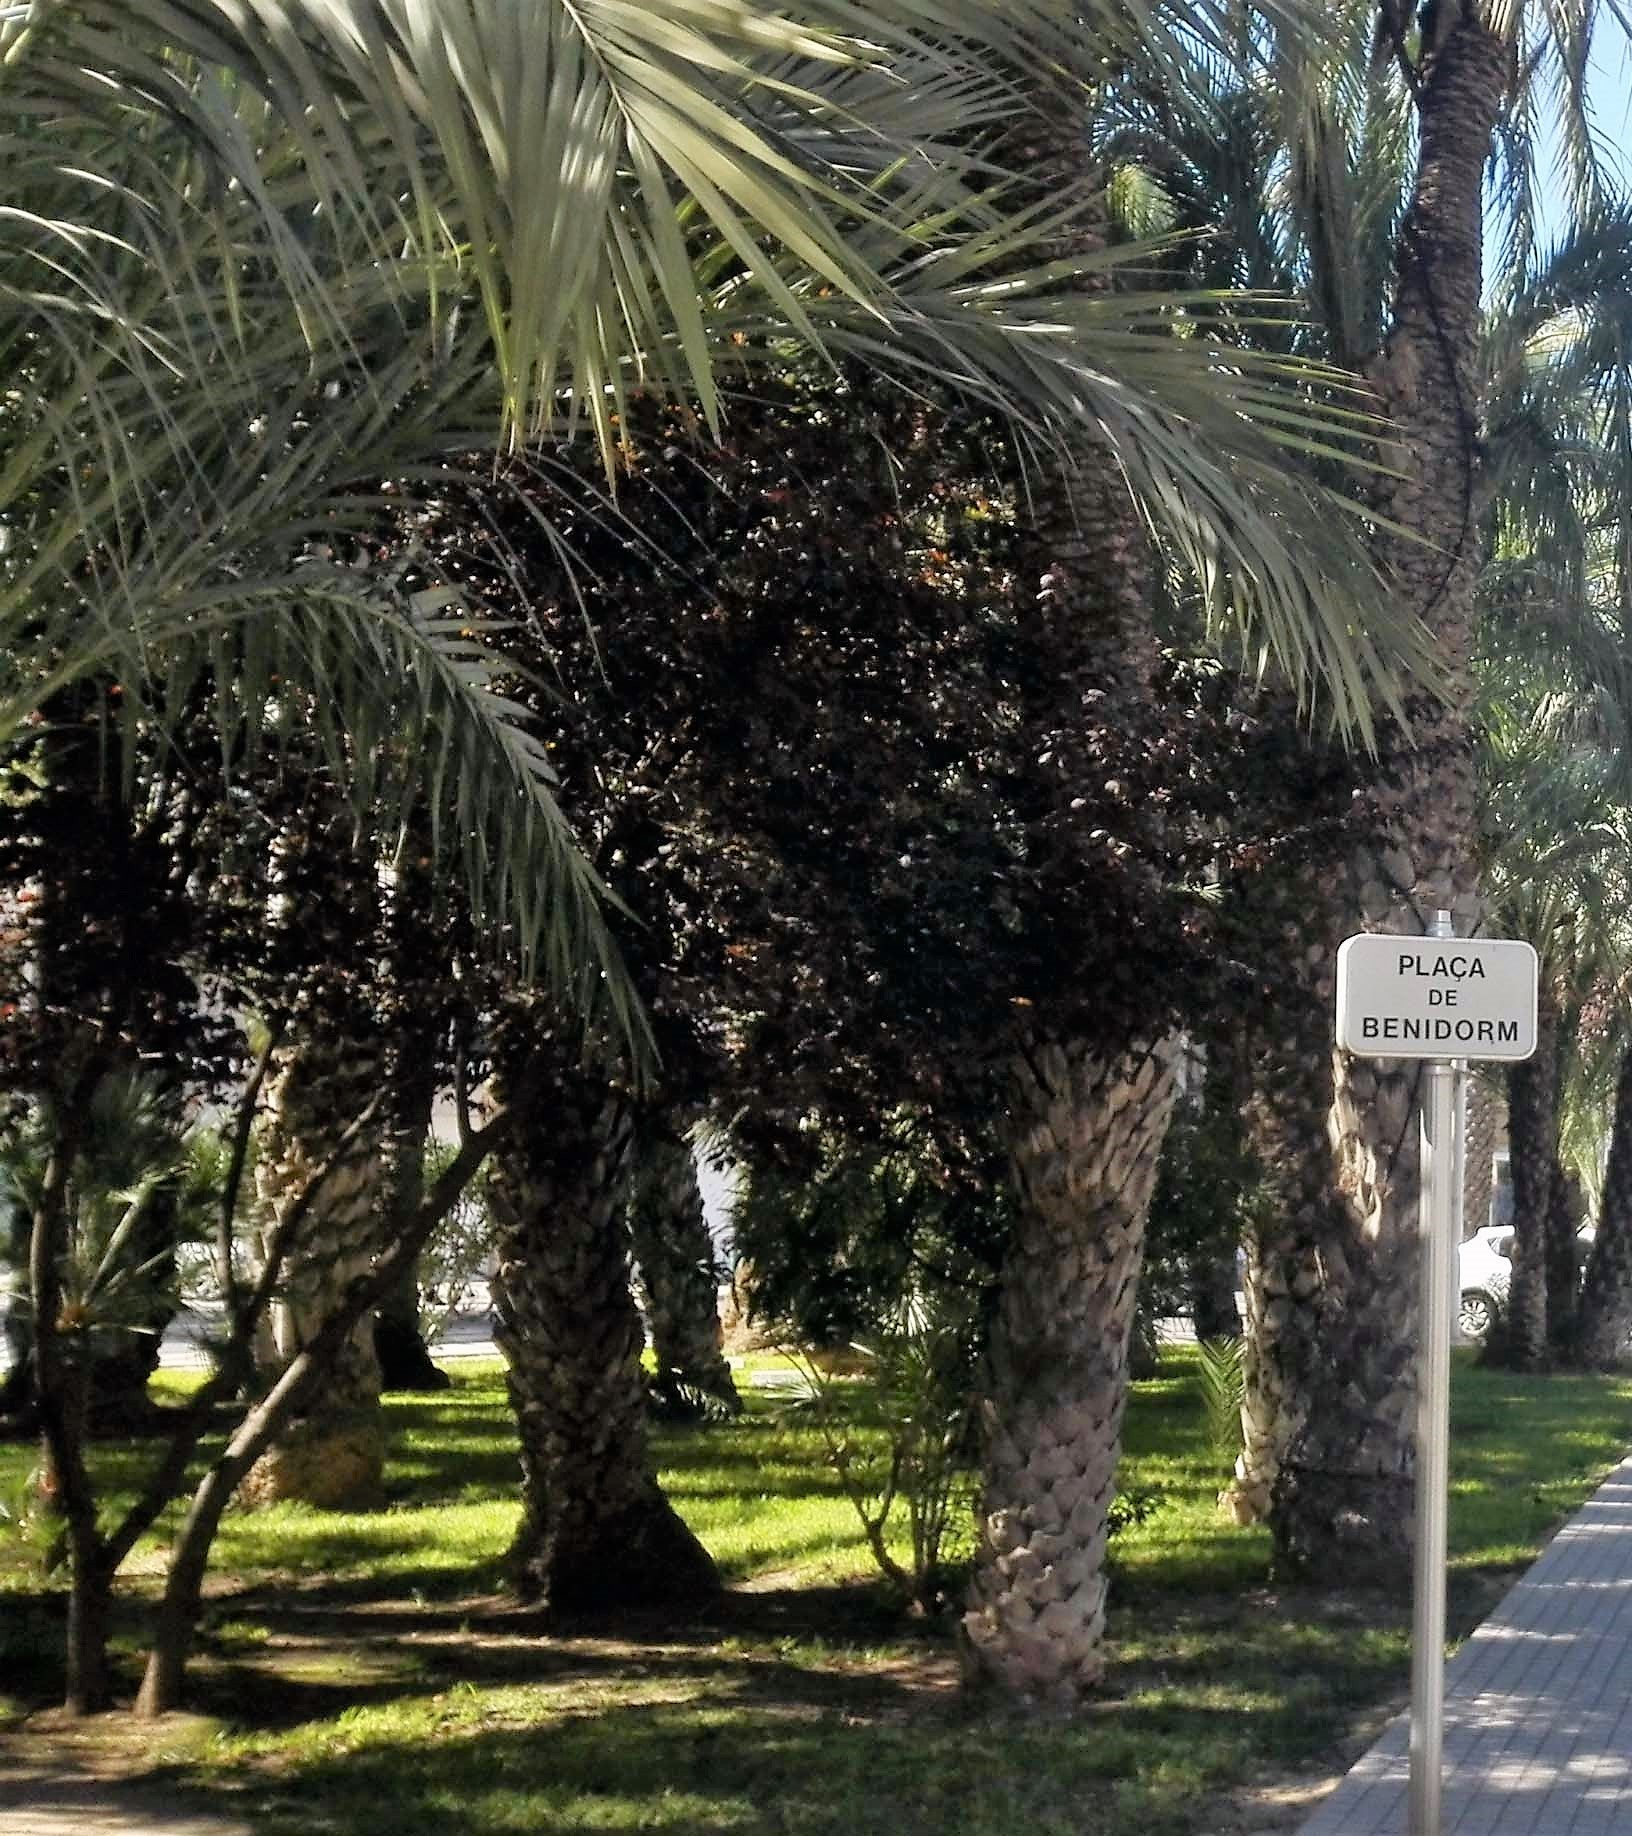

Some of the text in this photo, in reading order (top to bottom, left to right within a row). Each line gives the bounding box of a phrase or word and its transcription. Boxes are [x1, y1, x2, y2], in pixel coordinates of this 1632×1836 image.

[1399, 955, 1486, 982] PLAÇA
[1429, 989, 1458, 1006] DE
[1362, 1017, 1519, 1041] BENIDORM
